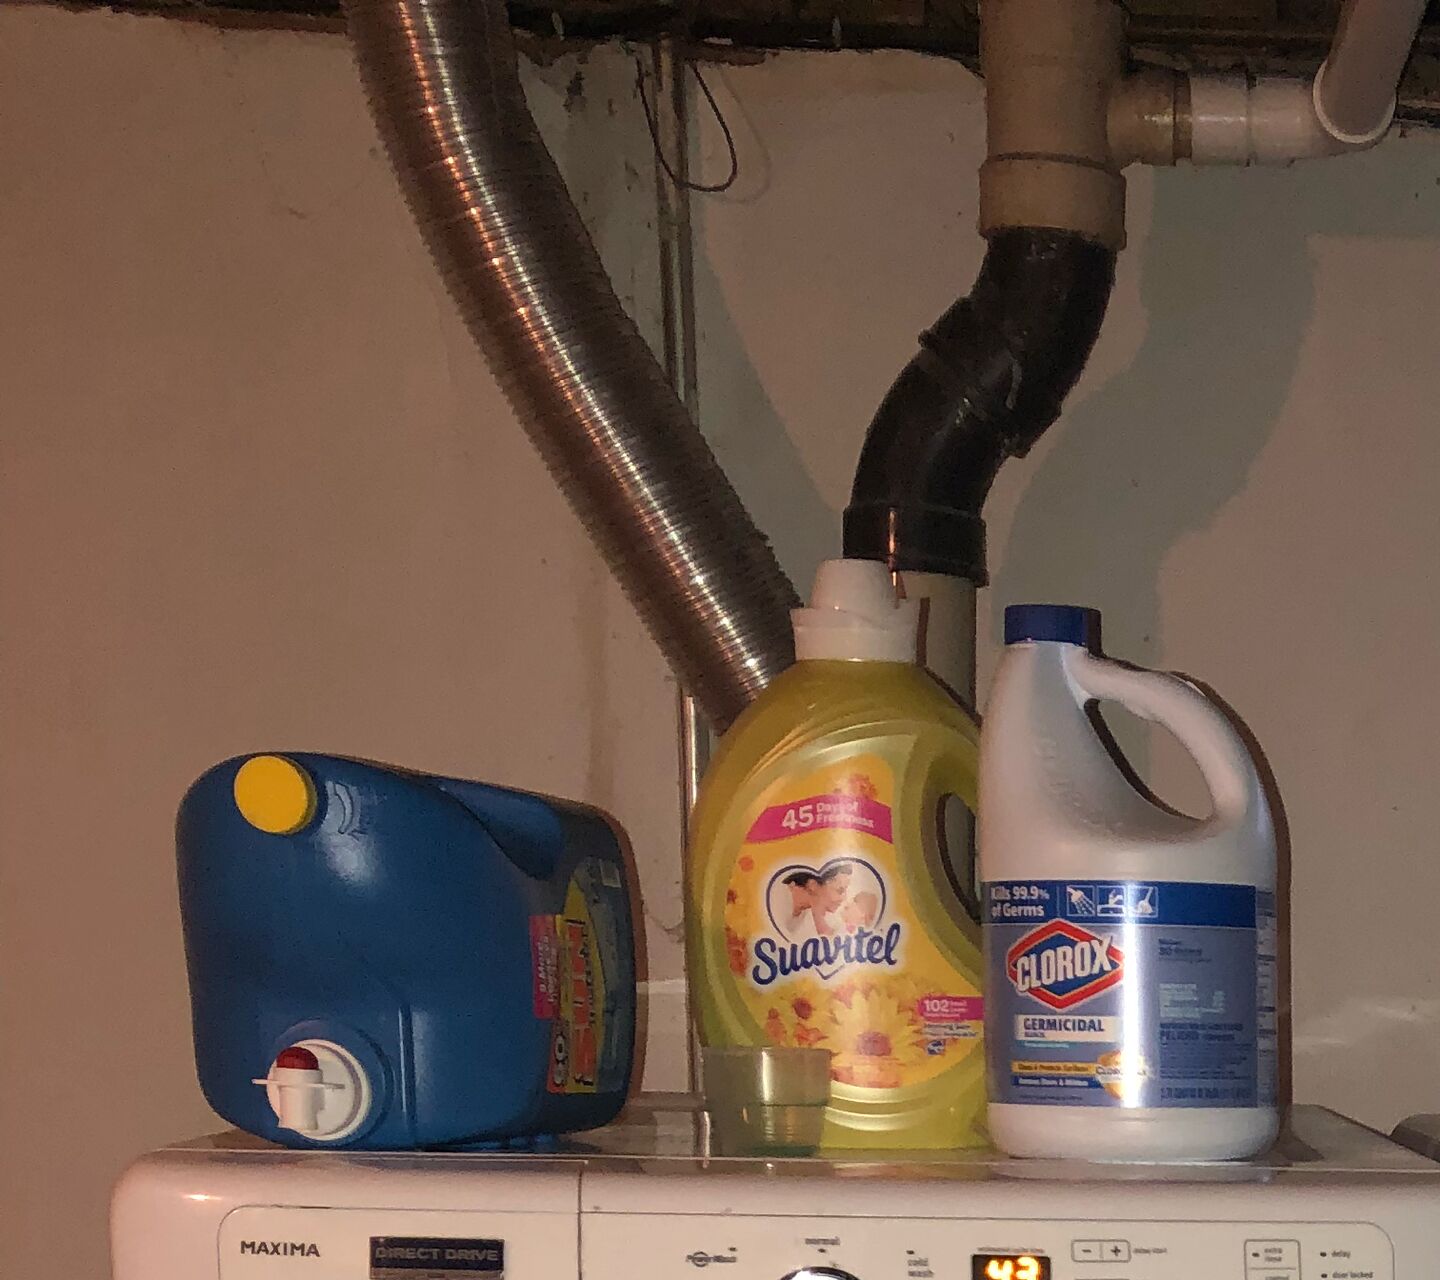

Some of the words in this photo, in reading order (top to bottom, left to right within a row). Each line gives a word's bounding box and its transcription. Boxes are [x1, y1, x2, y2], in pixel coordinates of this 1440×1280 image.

[782, 805, 814, 829] 45
[1003, 903, 1045, 917] Germs
[752, 922, 901, 986] Suavitel
[1016, 935, 1113, 992] CLOROX
[923, 999, 950, 1012] 102
[1023, 1018, 1105, 1032] GERMICIDAL
[240, 1240, 320, 1258] MAXIMA
[375, 1247, 441, 1260] DIRECT
[445, 1248, 499, 1262] DRIVE
